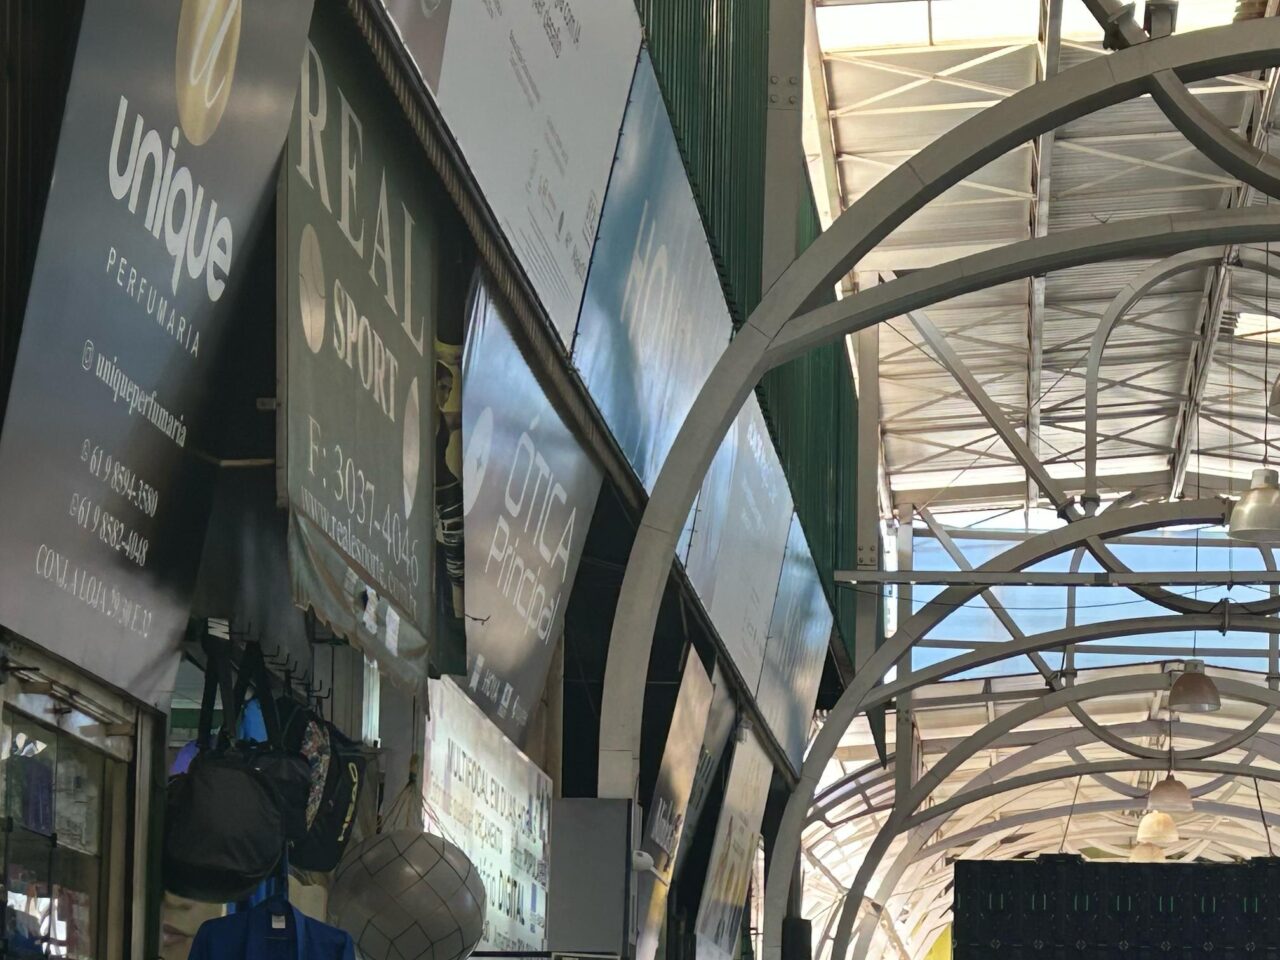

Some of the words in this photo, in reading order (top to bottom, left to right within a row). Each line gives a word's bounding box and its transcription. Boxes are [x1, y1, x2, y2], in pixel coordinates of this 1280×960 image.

[108, 95, 233, 301] unique
[296, 35, 424, 357] REAL
[106, 246, 200, 358] PERFUMARIA
[332, 278, 399, 423] SPORT
[95, 352, 188, 448] uniqueperfumaria
[333, 444, 419, 587] 3037-4046
[504, 414, 577, 583] ÓTICA
[485, 514, 562, 647] Principal
